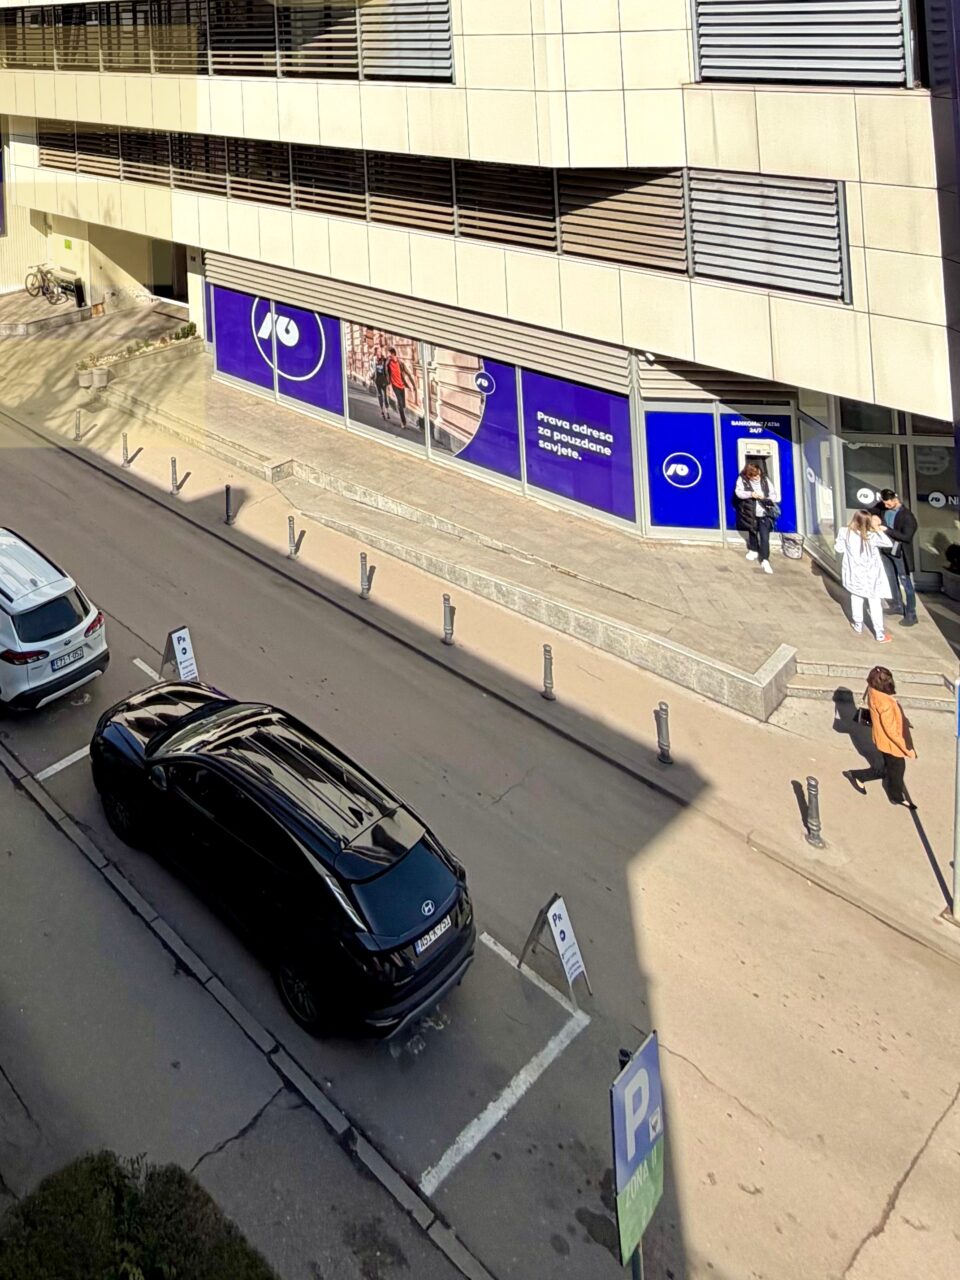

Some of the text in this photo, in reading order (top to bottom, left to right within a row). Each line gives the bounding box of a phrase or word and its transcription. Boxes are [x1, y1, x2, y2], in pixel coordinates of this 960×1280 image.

[536, 410, 614, 443] Prava adresa
[537, 426, 612, 456] za pouzdane
[538, 439, 583, 461] savjete.
[624, 1068, 650, 1161] P
[625, 1159, 650, 1208] ZONA
